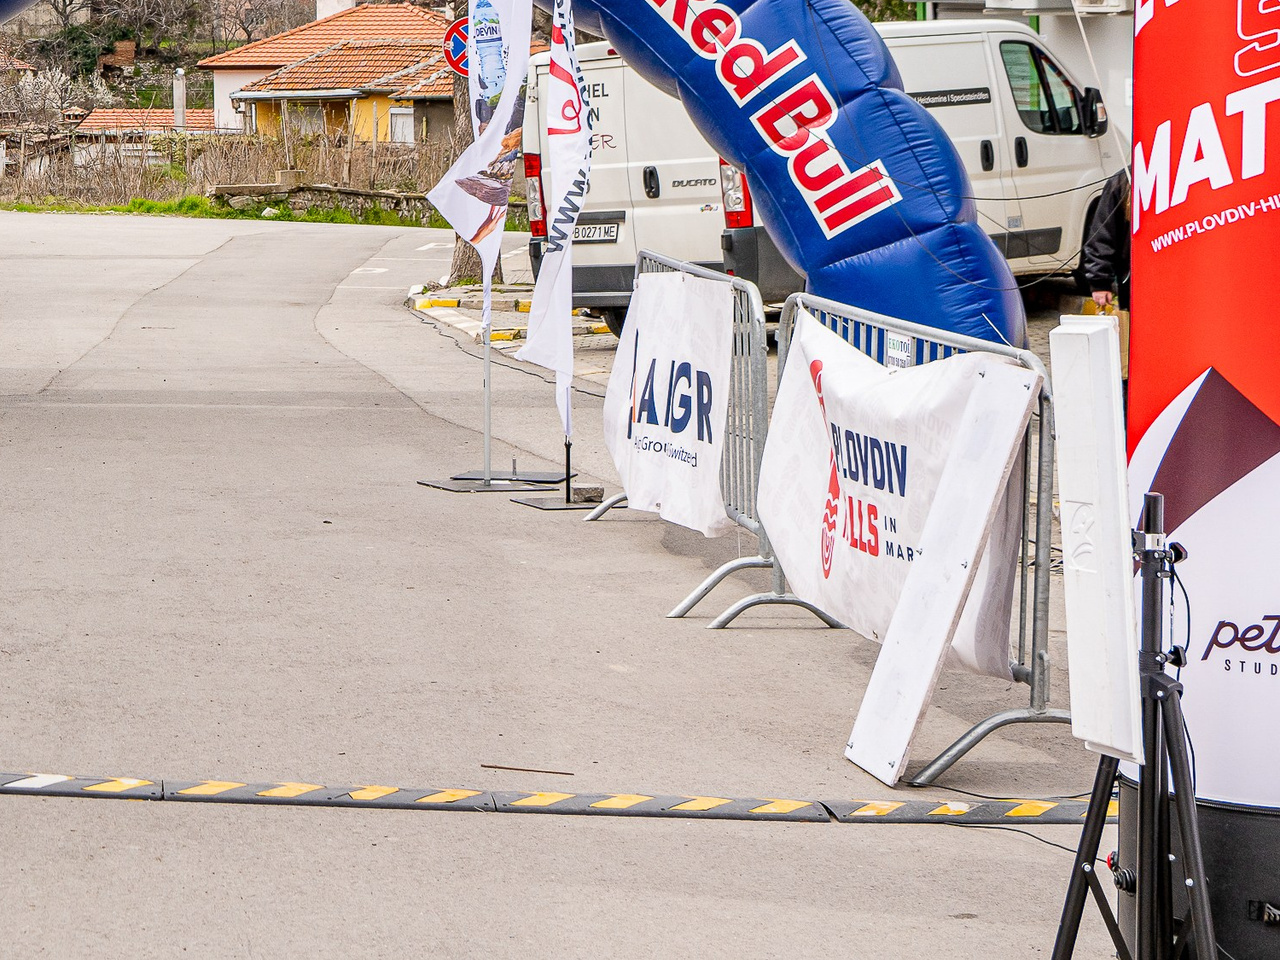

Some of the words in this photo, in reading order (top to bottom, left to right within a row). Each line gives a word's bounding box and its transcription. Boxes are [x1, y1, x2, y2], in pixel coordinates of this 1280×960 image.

[475, 24, 499, 37] DEVIN
[753, 76, 898, 236] Bull
[672, 178, 717, 188] DUCATO
[1150, 192, 1280, 253] WWW.PLOVDIV-HI
[581, 225, 603, 238] 0271
[603, 225, 616, 238] ME
[884, 514, 897, 534] IN
[1224, 659, 1279, 676] STUD
